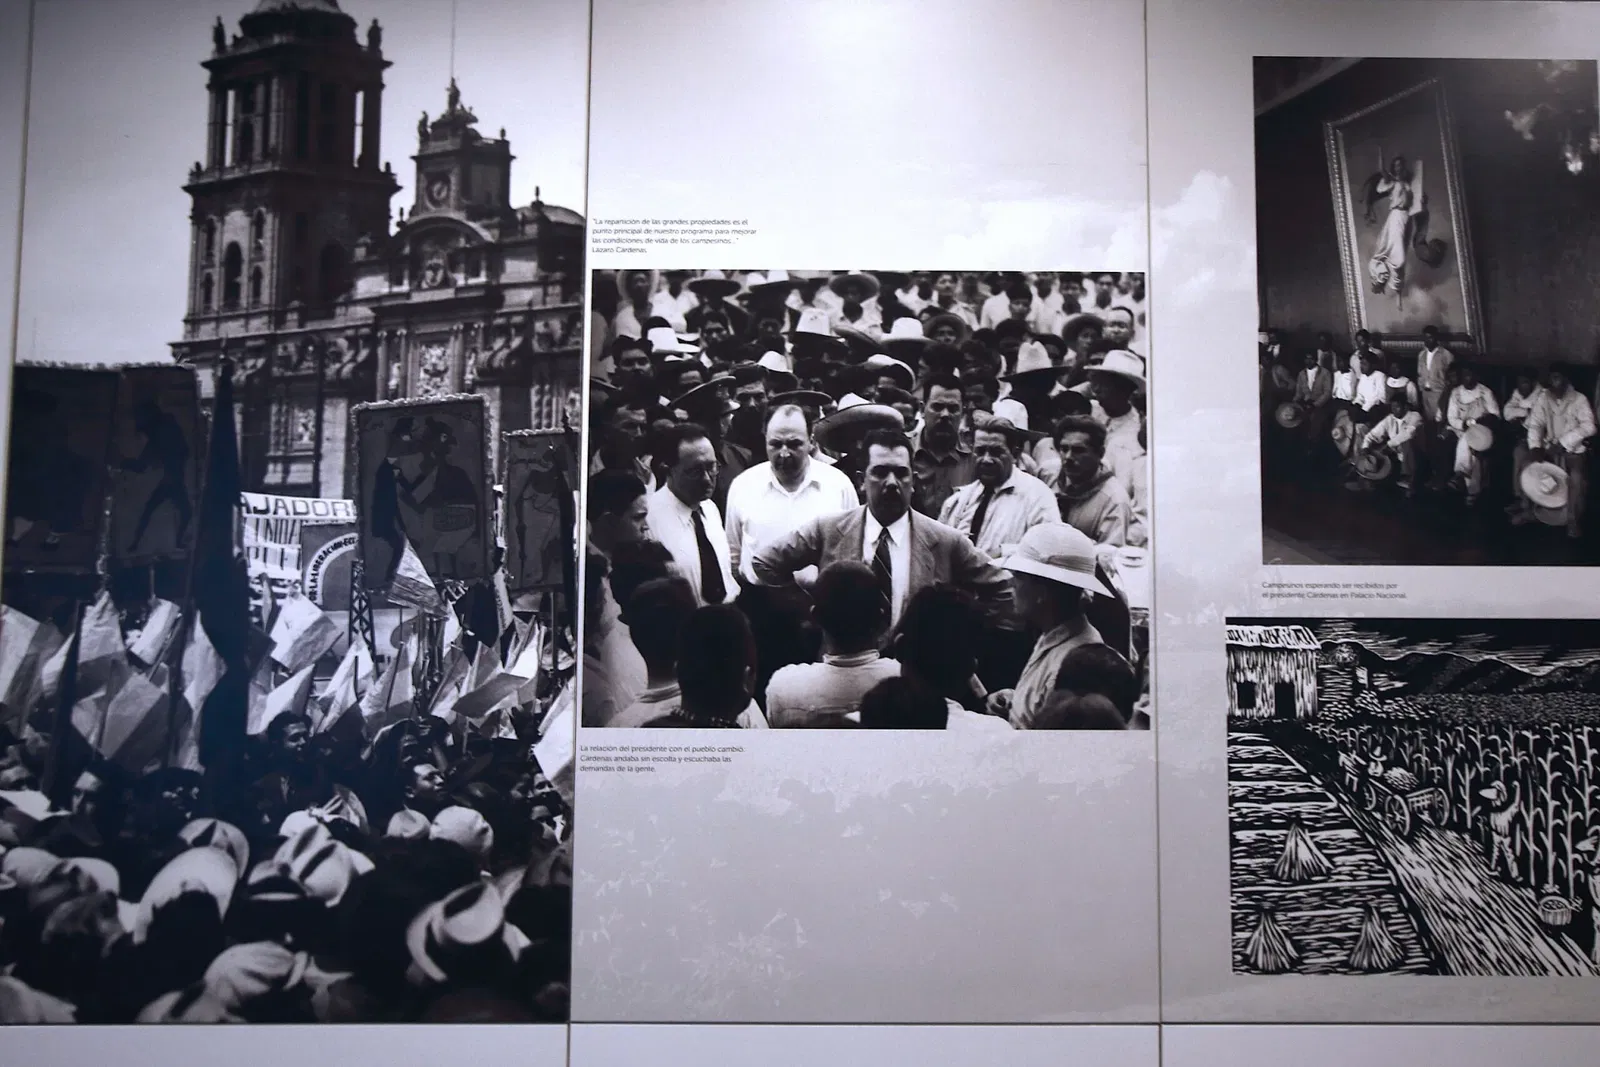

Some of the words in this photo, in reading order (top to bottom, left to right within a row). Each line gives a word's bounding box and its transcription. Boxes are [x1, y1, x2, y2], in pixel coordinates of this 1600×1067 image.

[662, 218, 689, 226] grandes
[690, 218, 732, 226] propiedades
[741, 218, 748, 226] el
[732, 228, 757, 236] mejorar
[240, 495, 351, 517] AJADOR
[1262, 582, 1304, 590] Campesinos
[1305, 582, 1341, 590] esperando
[1350, 591, 1375, 599] Palacio
[631, 745, 667, 753] presidente
[692, 745, 716, 753] pueblo
